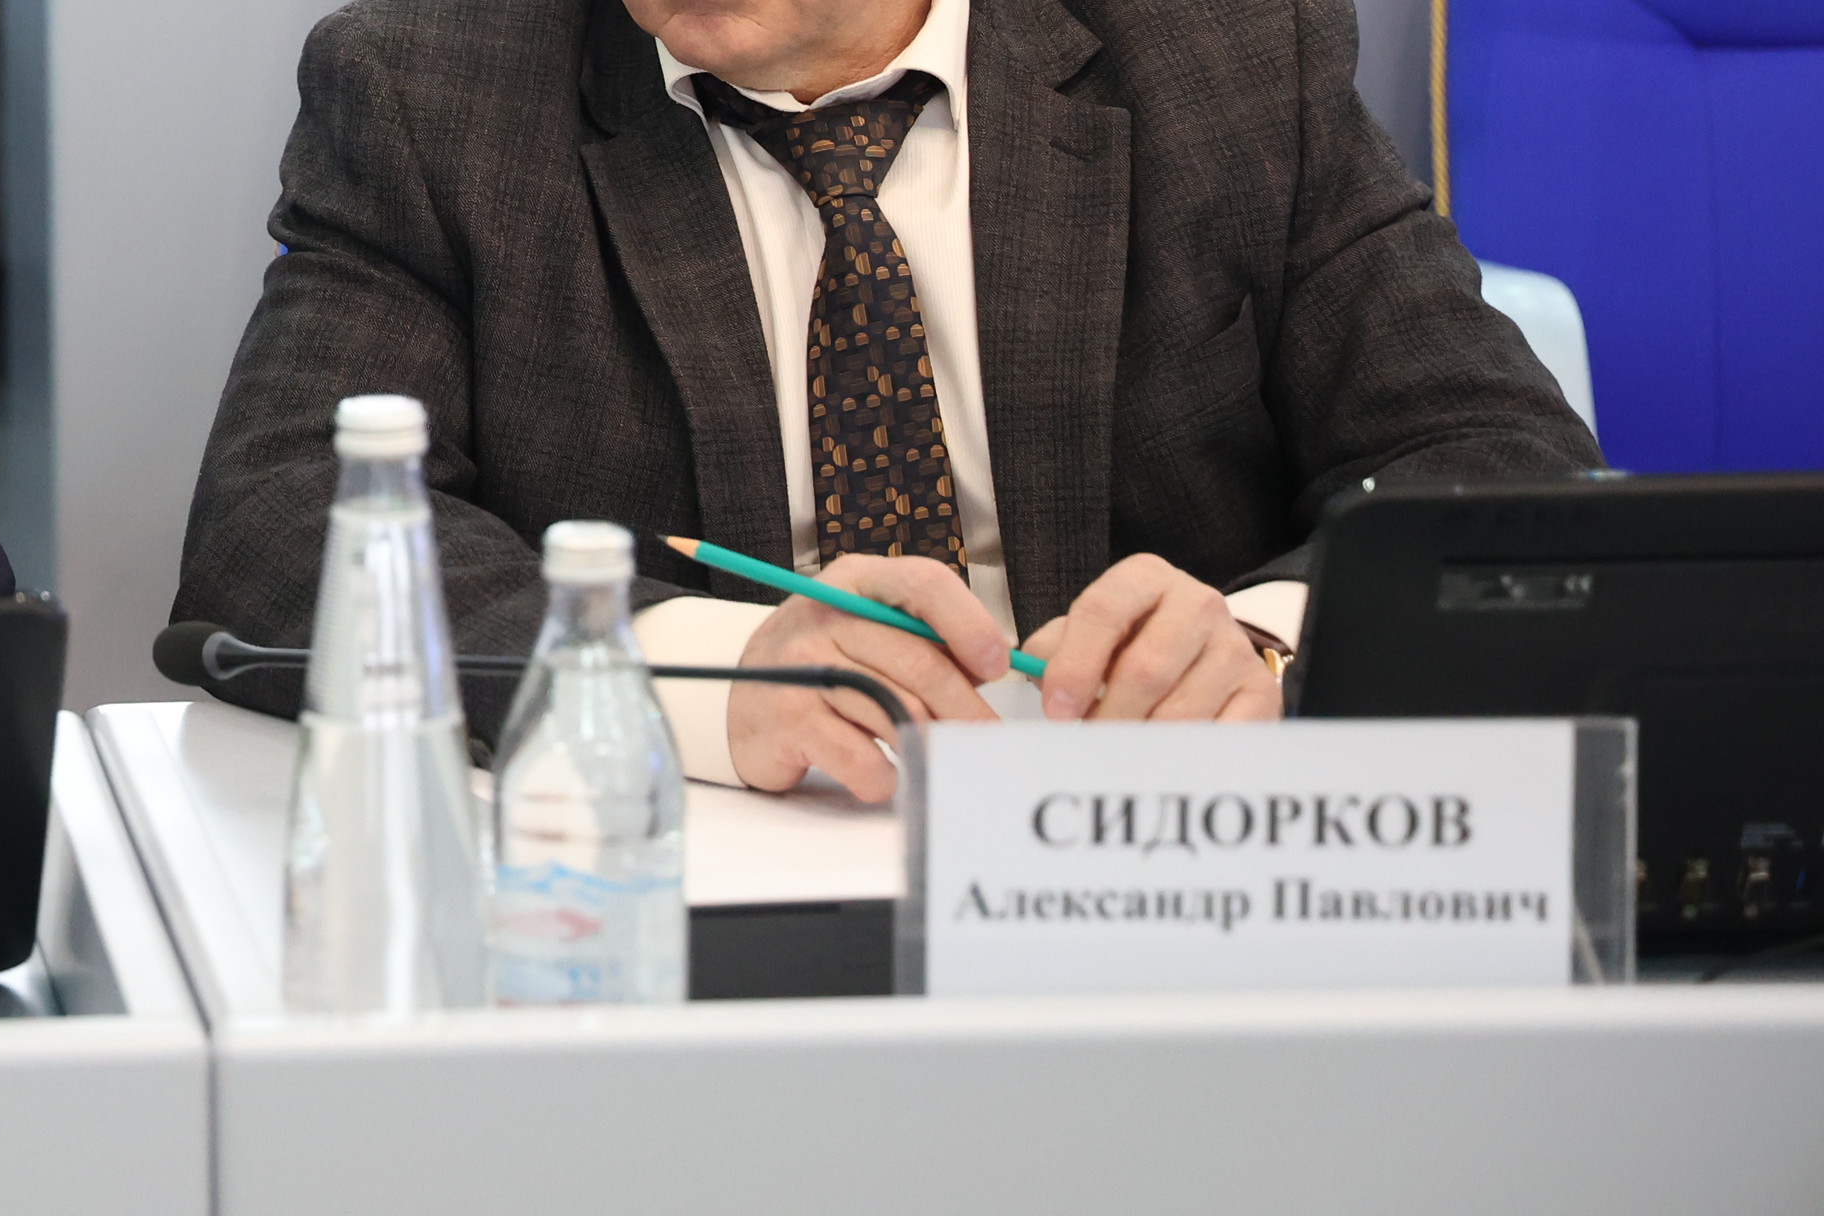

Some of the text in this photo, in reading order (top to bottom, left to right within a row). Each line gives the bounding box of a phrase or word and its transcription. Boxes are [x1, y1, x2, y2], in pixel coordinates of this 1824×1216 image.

[1031, 792, 1475, 857] СИДОРКОВ
[954, 878, 1550, 933] Александр Павлович
